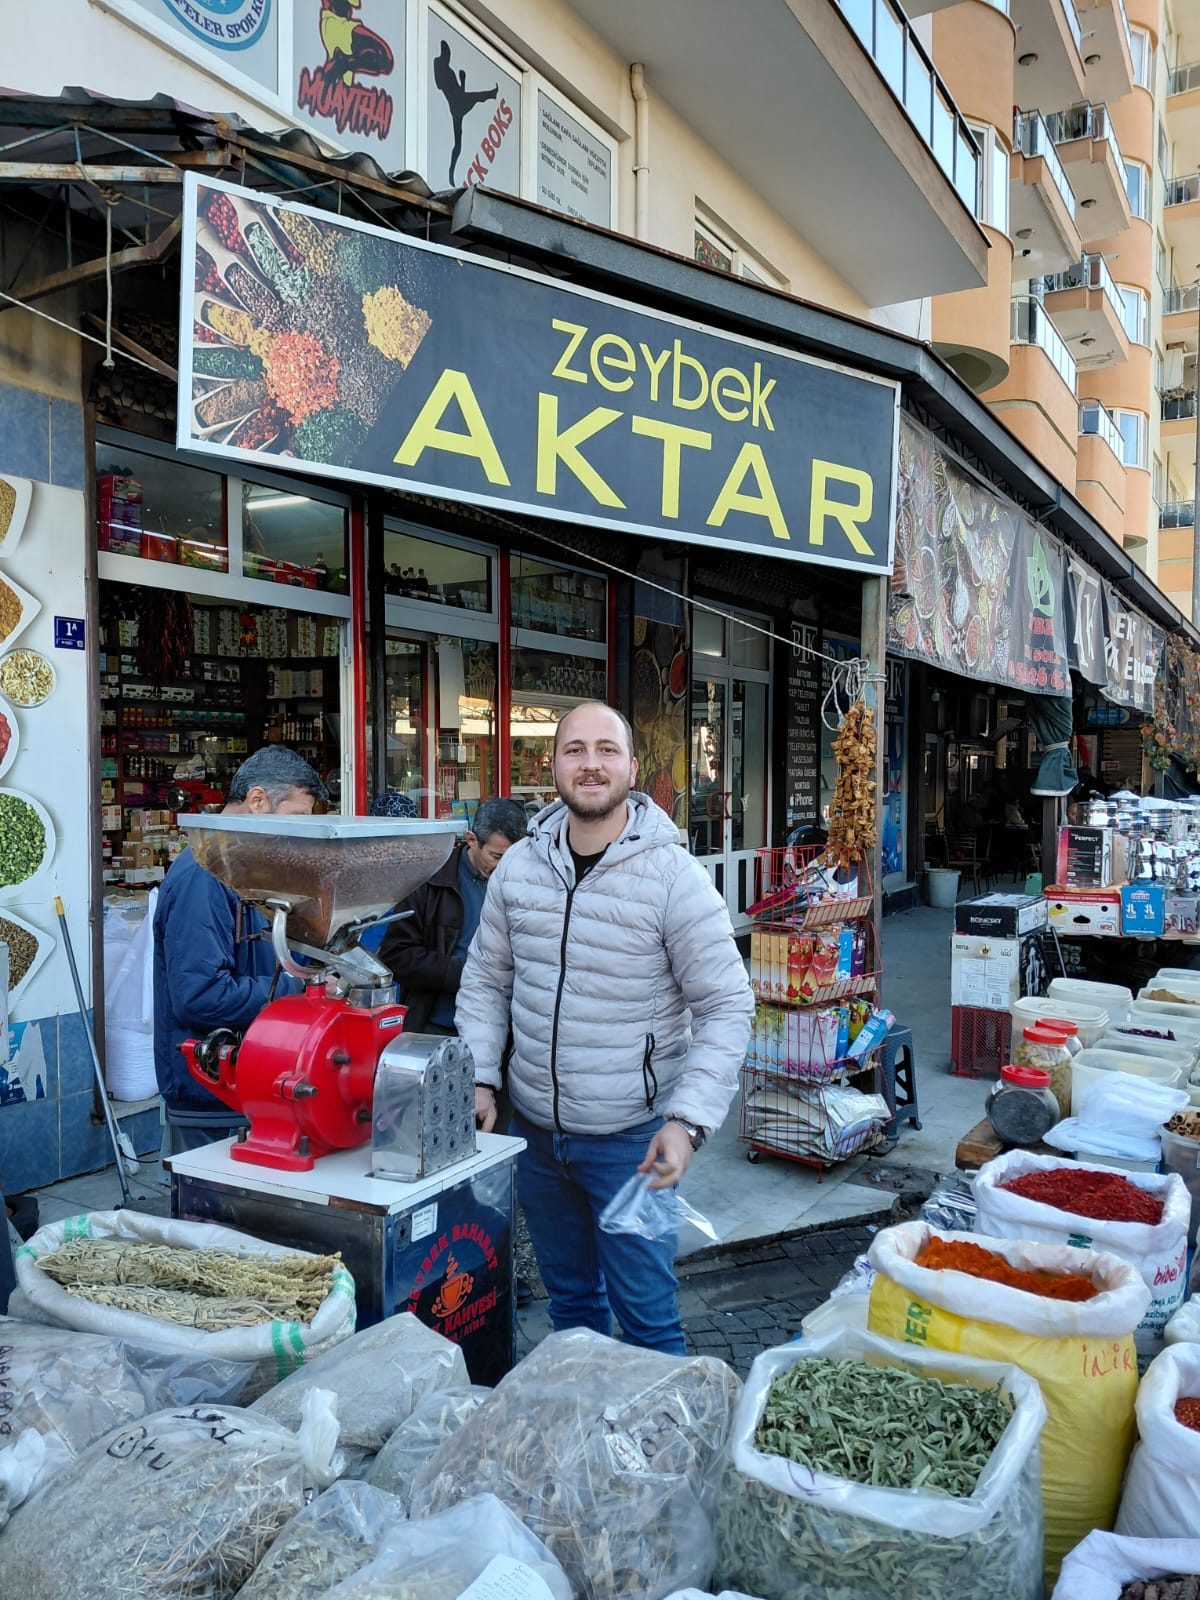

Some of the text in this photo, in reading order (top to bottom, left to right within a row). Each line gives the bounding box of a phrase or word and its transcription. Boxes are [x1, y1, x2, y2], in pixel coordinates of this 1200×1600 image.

[226, 13, 257, 38] SPOR
[298, 65, 393, 141] MUAYTHAI
[481, 98, 513, 163] BOKS
[393, 368, 875, 556] AKTAR
[451, 1222, 498, 1271] BAHARAT
[444, 1285, 497, 1335] KAHVESİ
